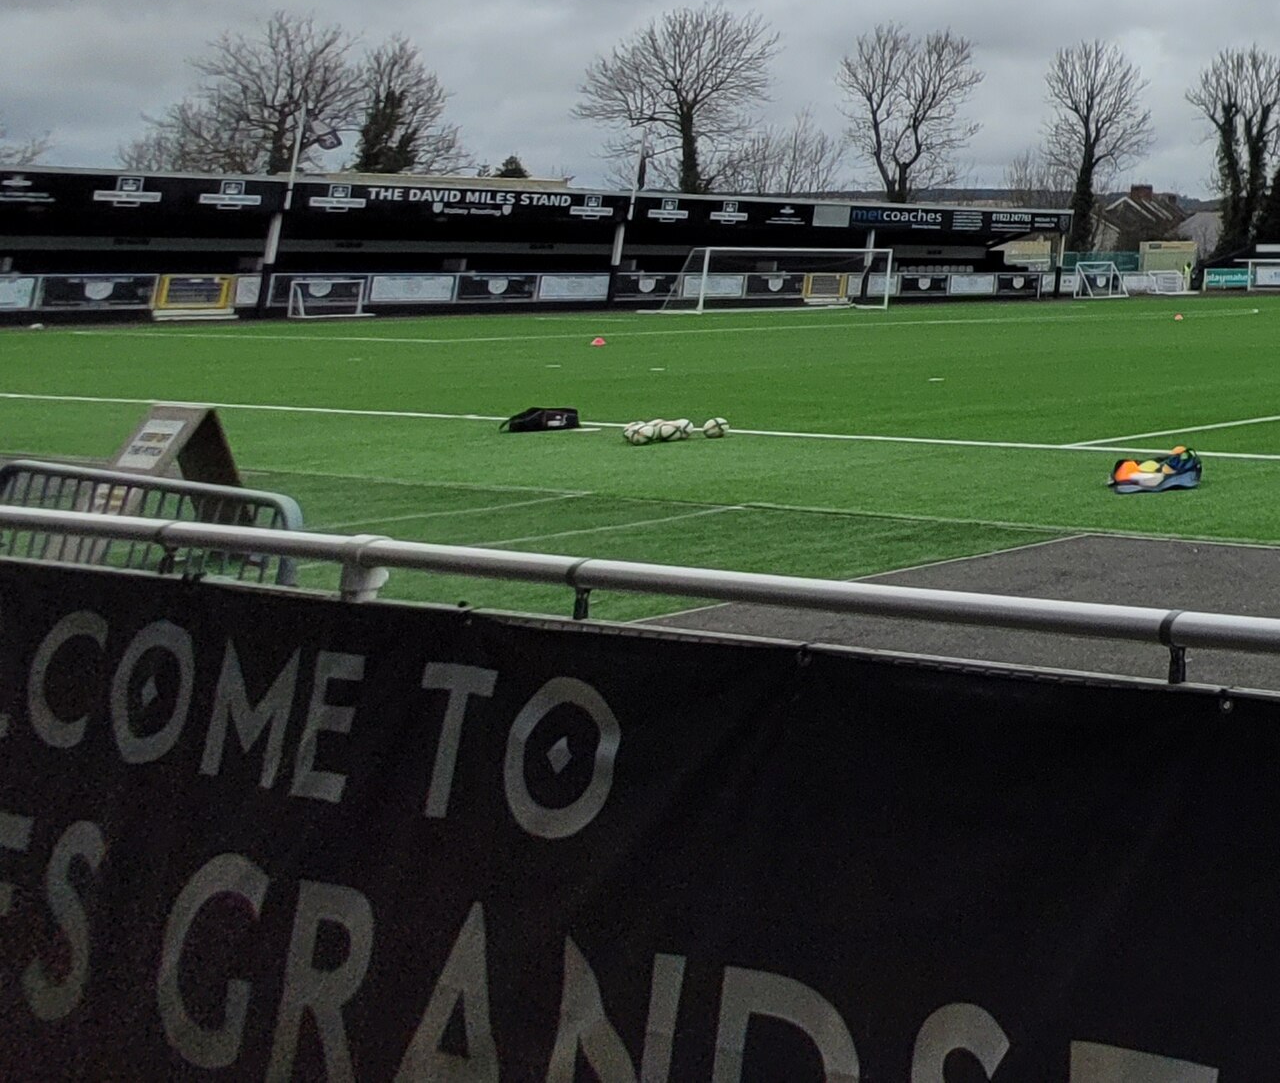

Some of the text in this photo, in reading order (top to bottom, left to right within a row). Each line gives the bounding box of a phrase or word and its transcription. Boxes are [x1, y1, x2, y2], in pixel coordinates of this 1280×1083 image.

[368, 187, 571, 207] THE DAVID MILES STAND
[852, 207, 942, 223] metcoaches
[0, 610, 621, 840] COME TO
[157, 853, 1218, 1083] GRAND
